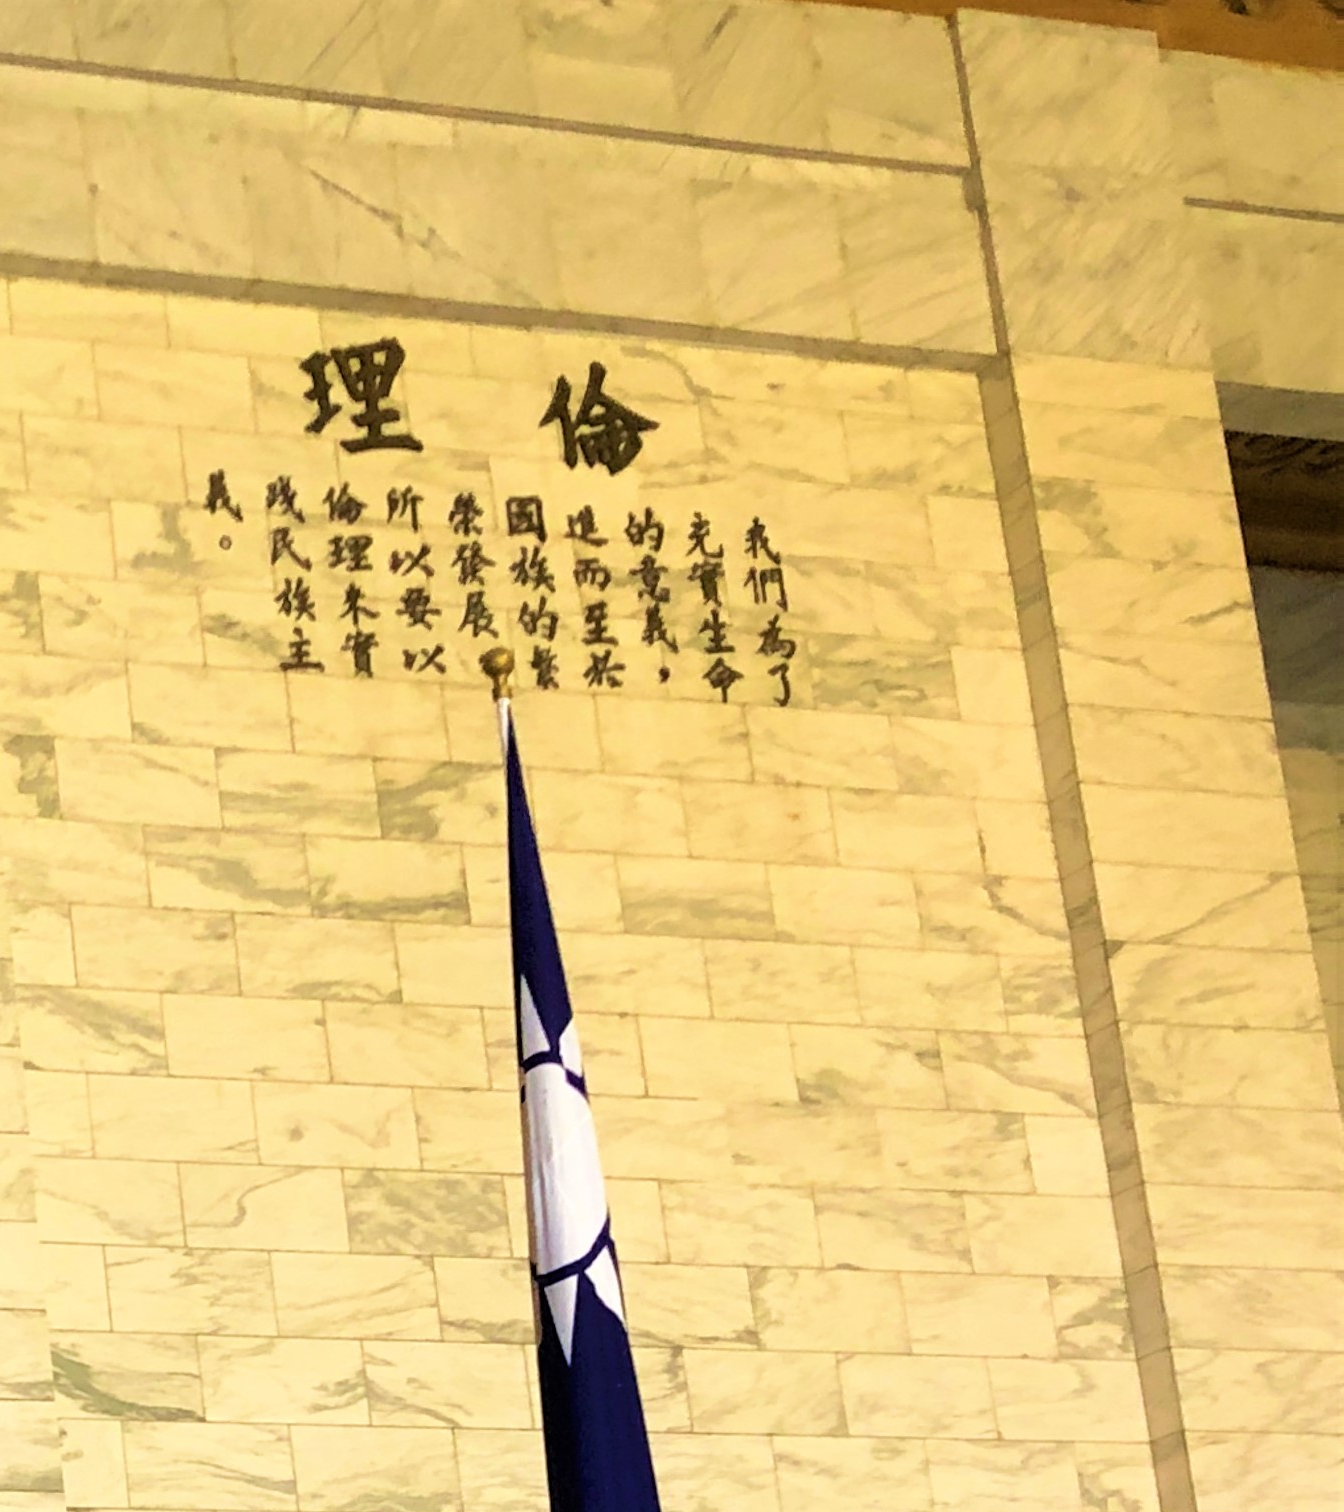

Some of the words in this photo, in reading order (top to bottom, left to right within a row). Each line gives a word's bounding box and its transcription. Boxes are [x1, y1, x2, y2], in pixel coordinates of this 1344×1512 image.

[385, 485, 448, 674] 所以要以
[686, 511, 744, 703] 充實生命
[744, 516, 798, 707] 我們為了
